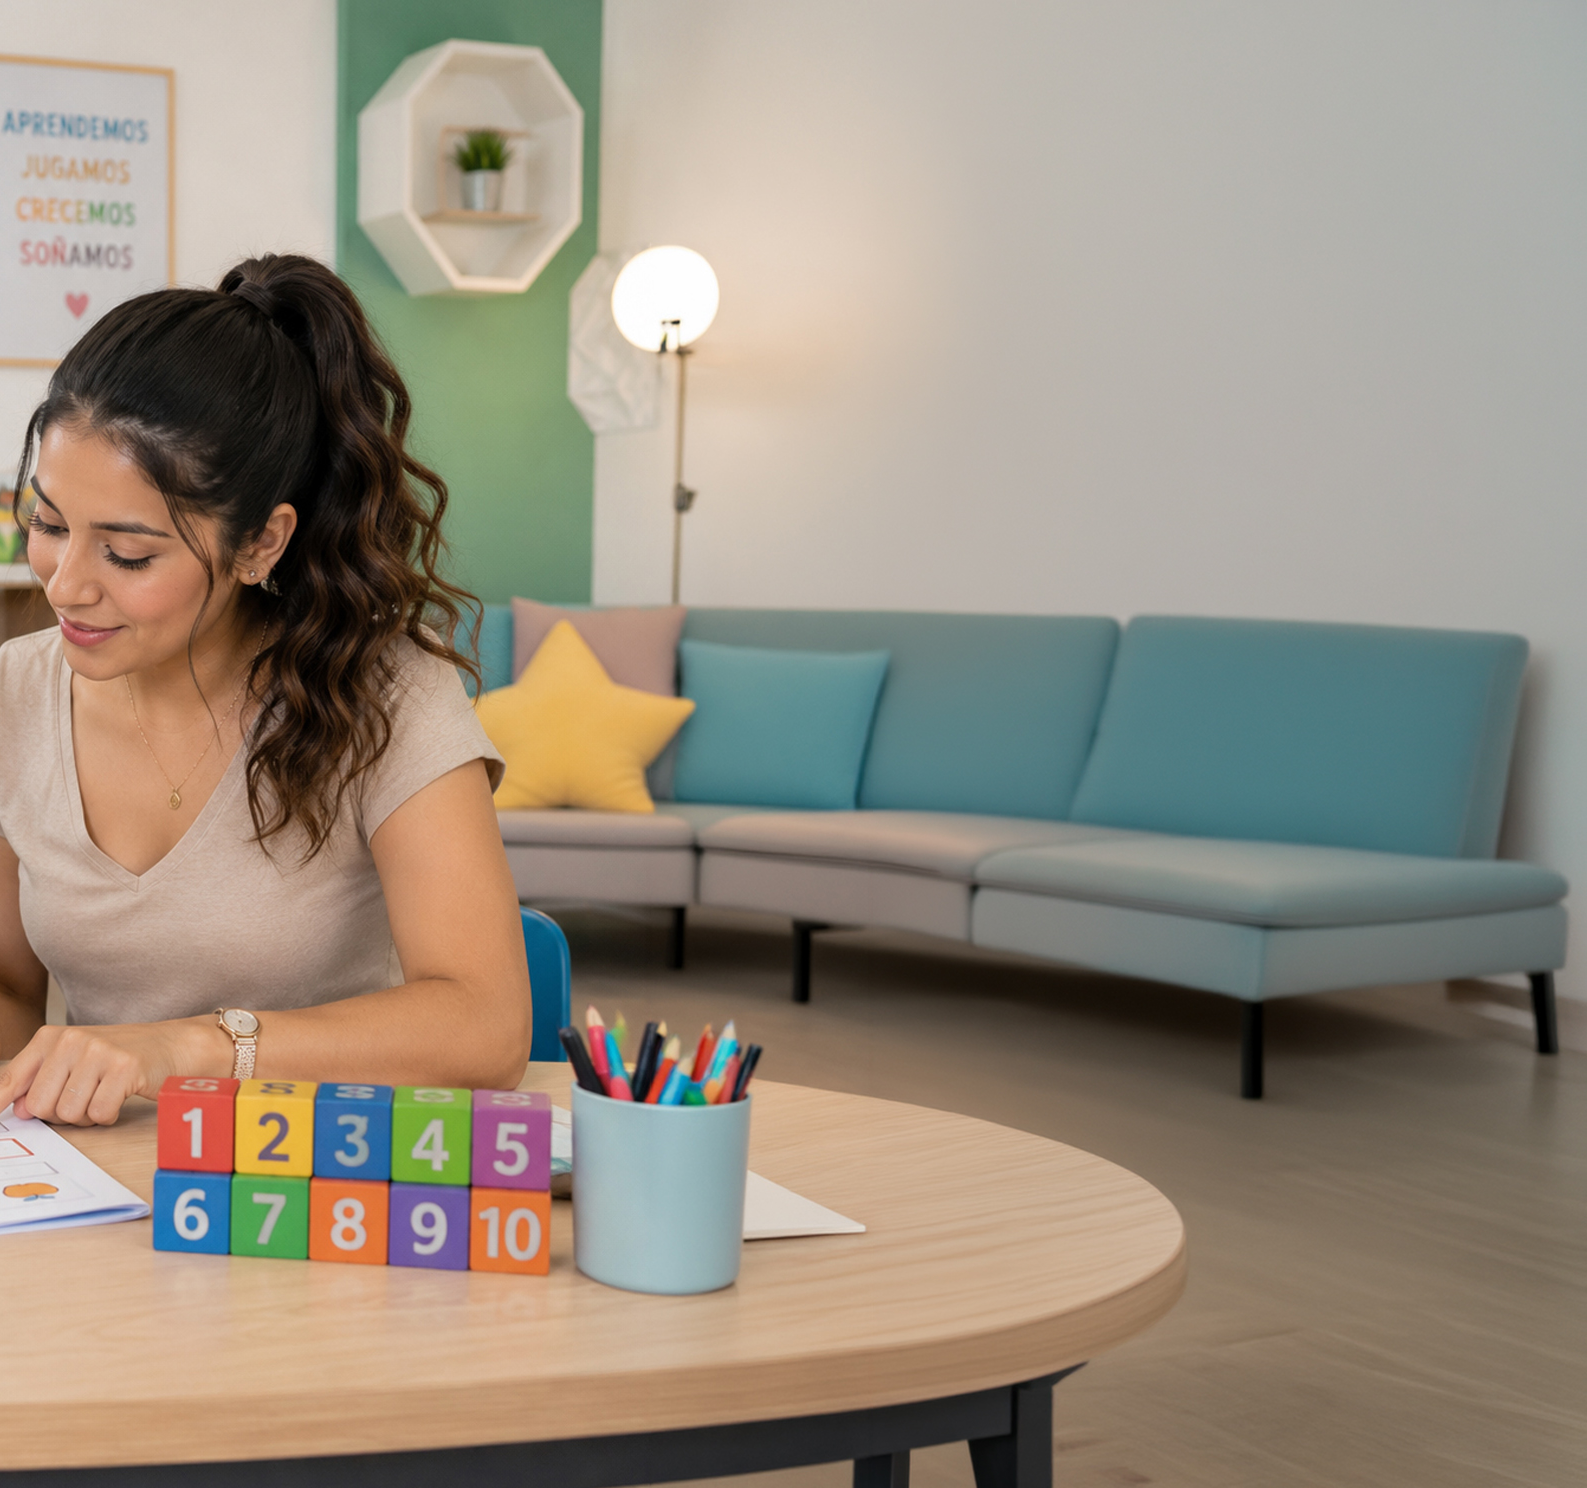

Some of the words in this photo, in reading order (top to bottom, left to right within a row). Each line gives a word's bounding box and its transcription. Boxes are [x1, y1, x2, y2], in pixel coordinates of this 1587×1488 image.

[2, 110, 149, 143] APRENDEMOS
[21, 155, 131, 185] JUGAMOS
[16, 197, 137, 227] CRECEMOS
[20, 237, 134, 271] SOÑAMOS
[182, 1107, 203, 1158] 1
[257, 1112, 290, 1162] 2
[334, 1114, 370, 1167] 3
[411, 1119, 450, 1172] 4
[493, 1122, 530, 1176] 5
[173, 1188, 210, 1241] 6
[252, 1192, 287, 1245] 7
[330, 1197, 368, 1251] 8
[410, 1202, 448, 1255] 9
[478, 1206, 542, 1261] 10
